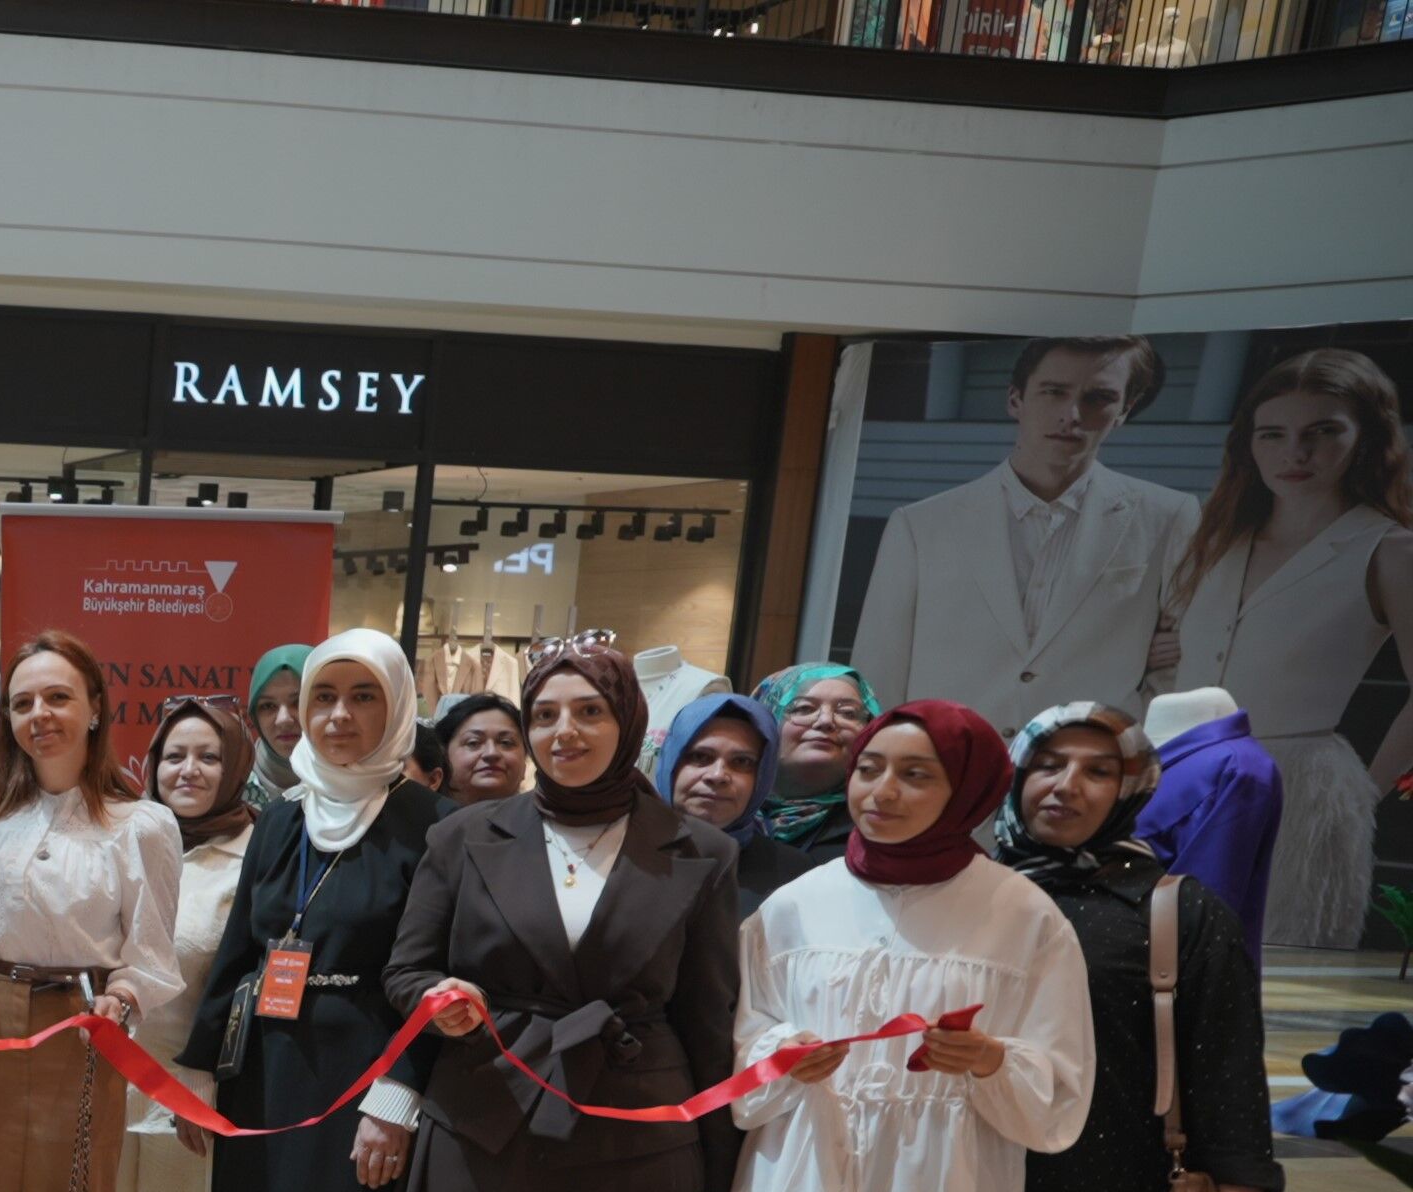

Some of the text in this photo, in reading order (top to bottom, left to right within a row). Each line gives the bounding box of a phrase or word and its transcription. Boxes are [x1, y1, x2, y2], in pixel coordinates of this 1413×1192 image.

[172, 361, 426, 415] RAMSEY
[83, 578, 206, 600] Kahramanmaraş
[83, 597, 205, 617] Büyükşehir Belediyesi
[140, 664, 241, 689] SANAT
